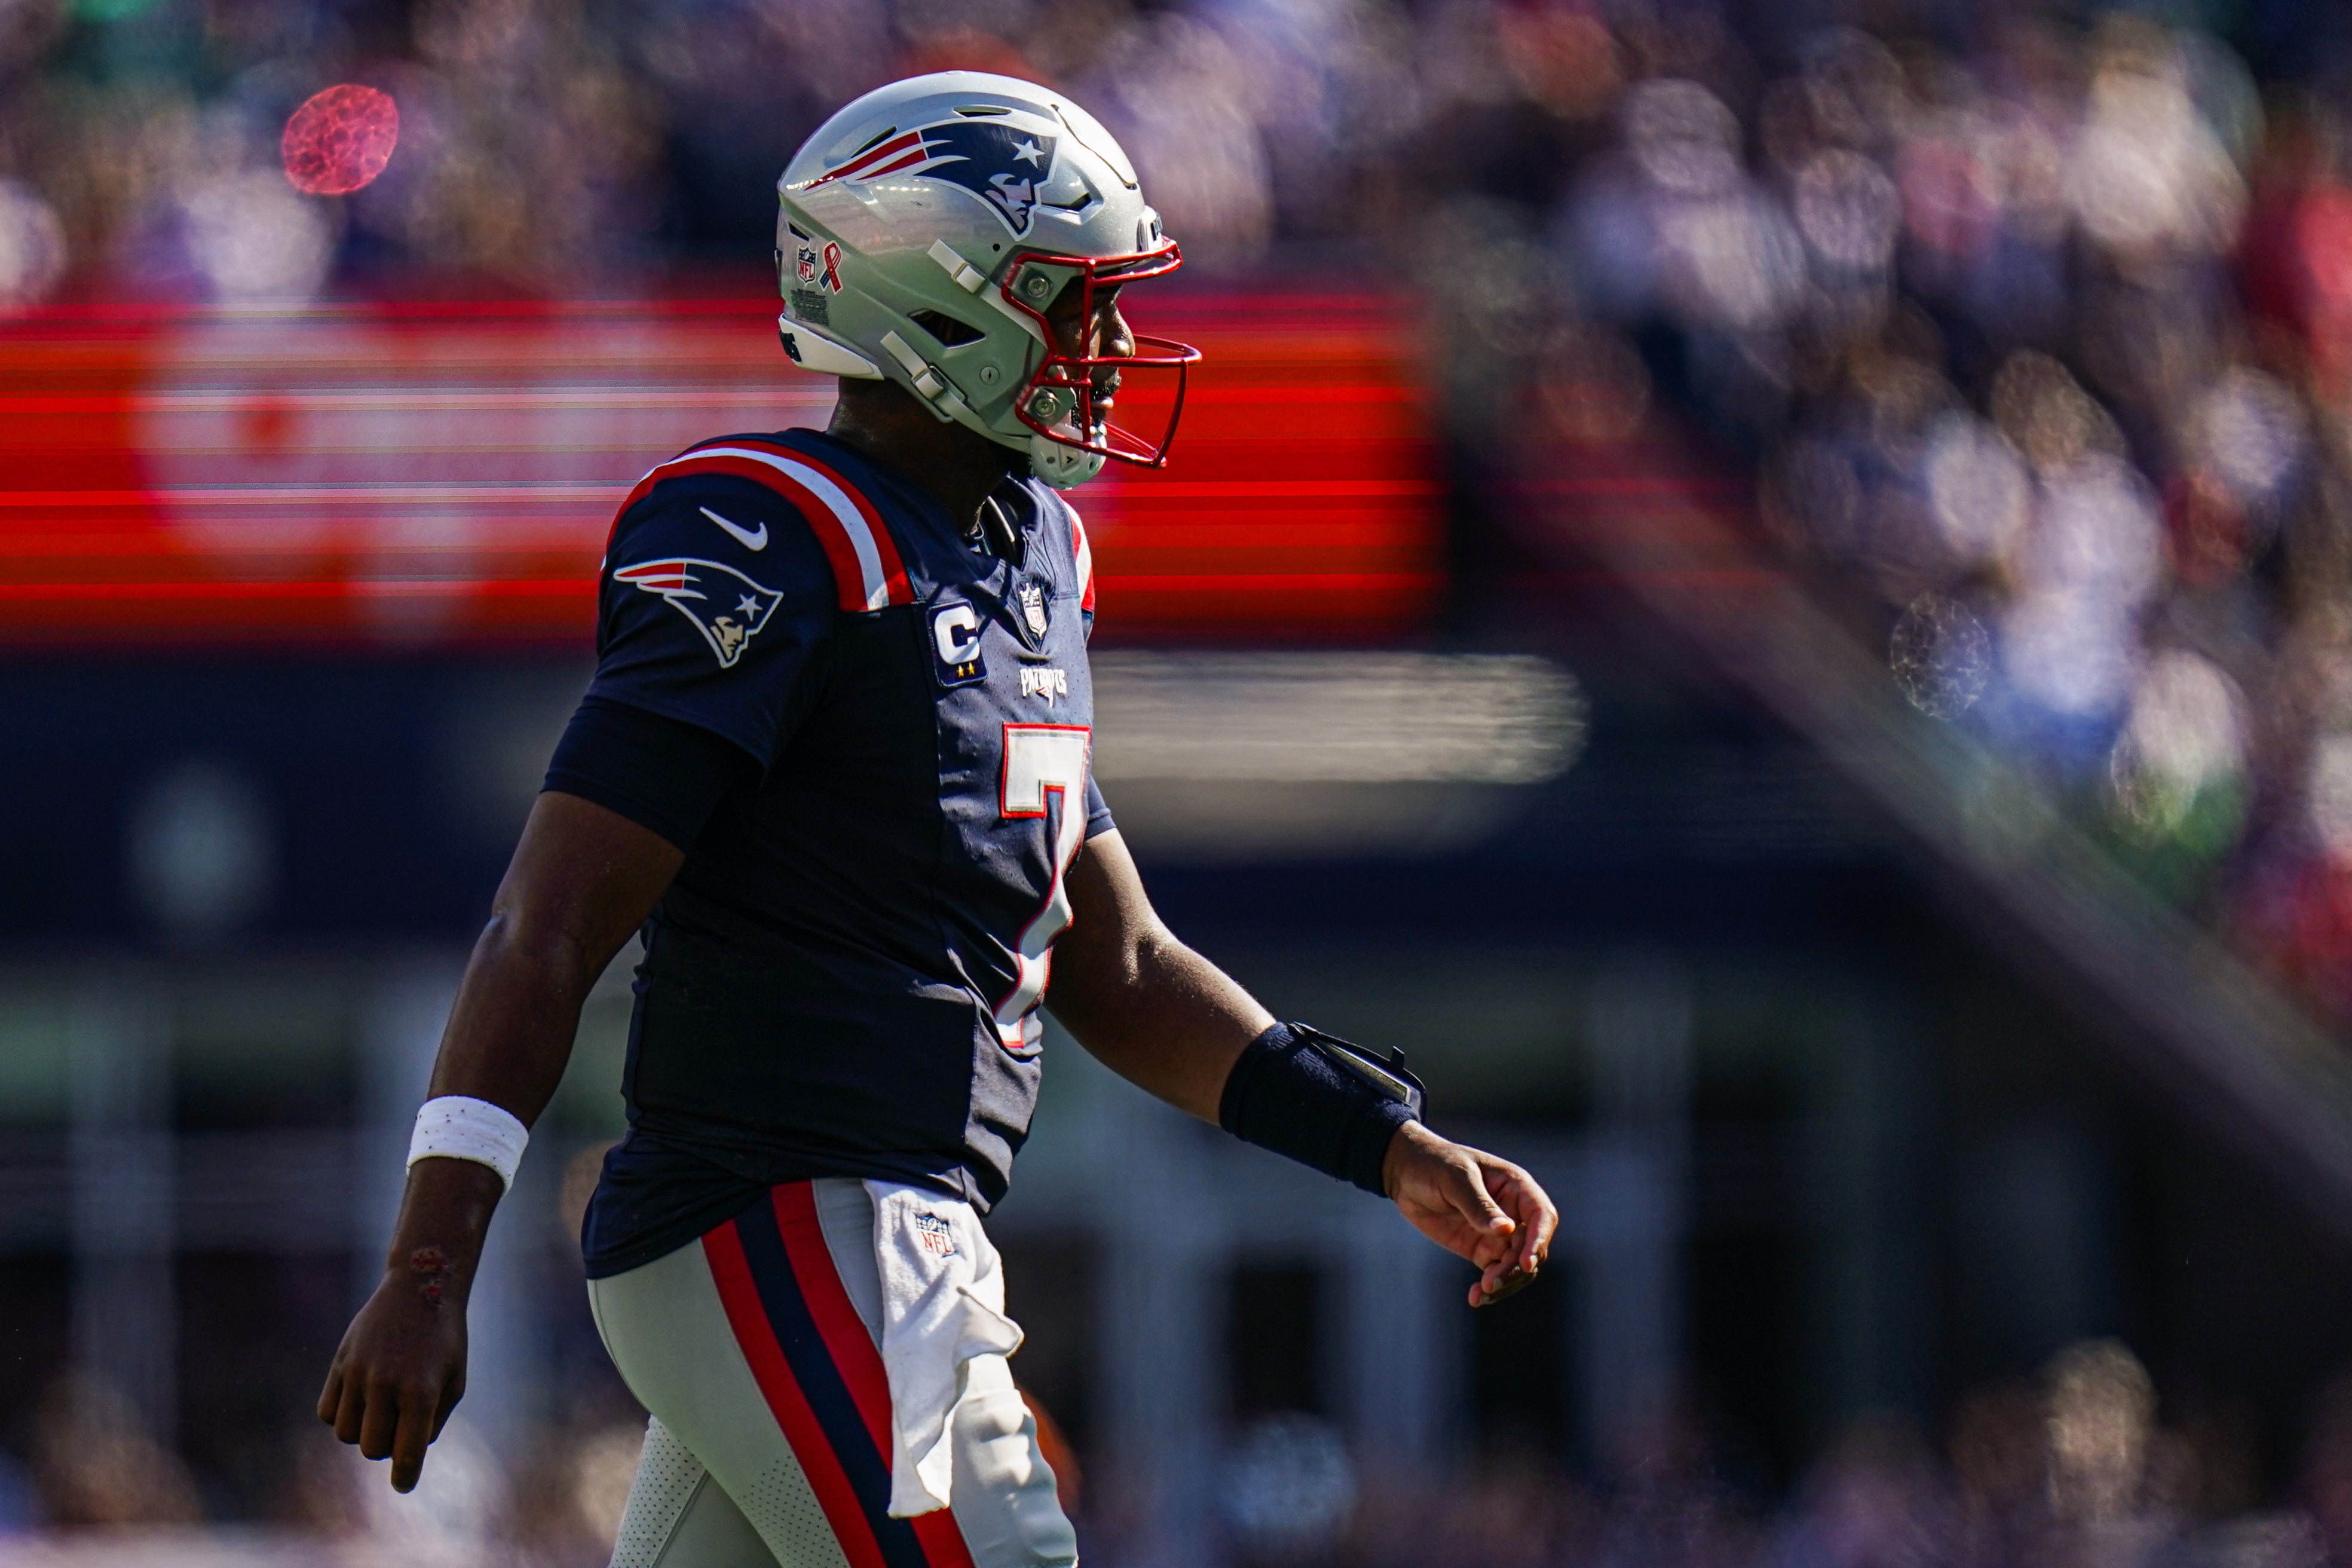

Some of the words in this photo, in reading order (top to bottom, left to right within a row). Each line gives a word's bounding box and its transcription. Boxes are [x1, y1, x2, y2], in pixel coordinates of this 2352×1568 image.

[799, 261, 814, 278] NFL
[934, 605, 980, 665] C
[1019, 668, 1067, 698] PATRIOTS
[993, 722, 1092, 1048] 7
[921, 1231, 953, 1254] NFL
